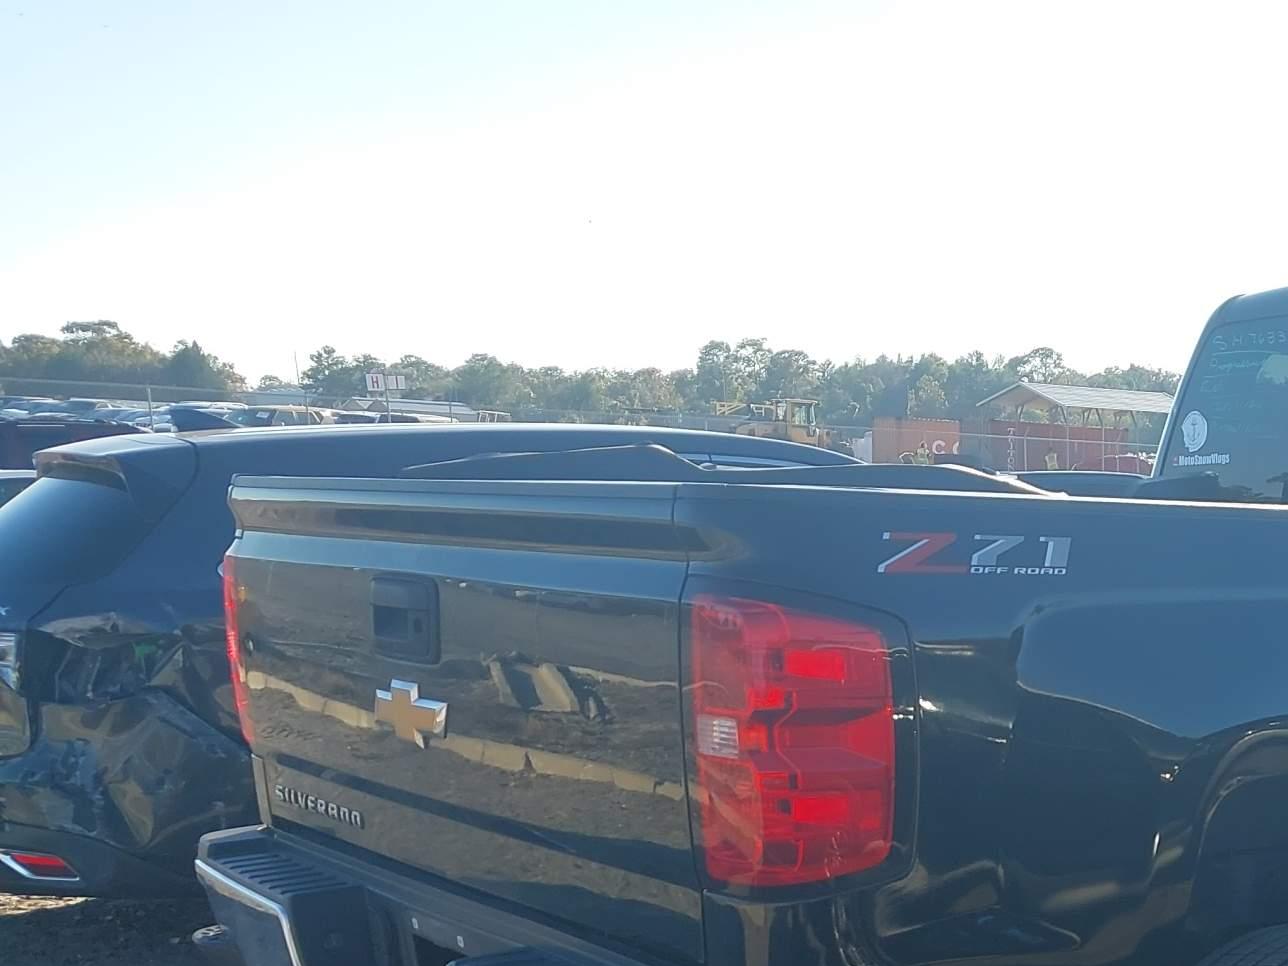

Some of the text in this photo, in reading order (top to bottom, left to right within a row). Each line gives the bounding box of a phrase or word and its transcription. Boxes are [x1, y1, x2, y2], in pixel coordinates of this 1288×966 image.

[877, 531, 1072, 576] Z71
[970, 566, 1067, 576] OFF ROAD
[274, 784, 362, 827] SILVERADO
